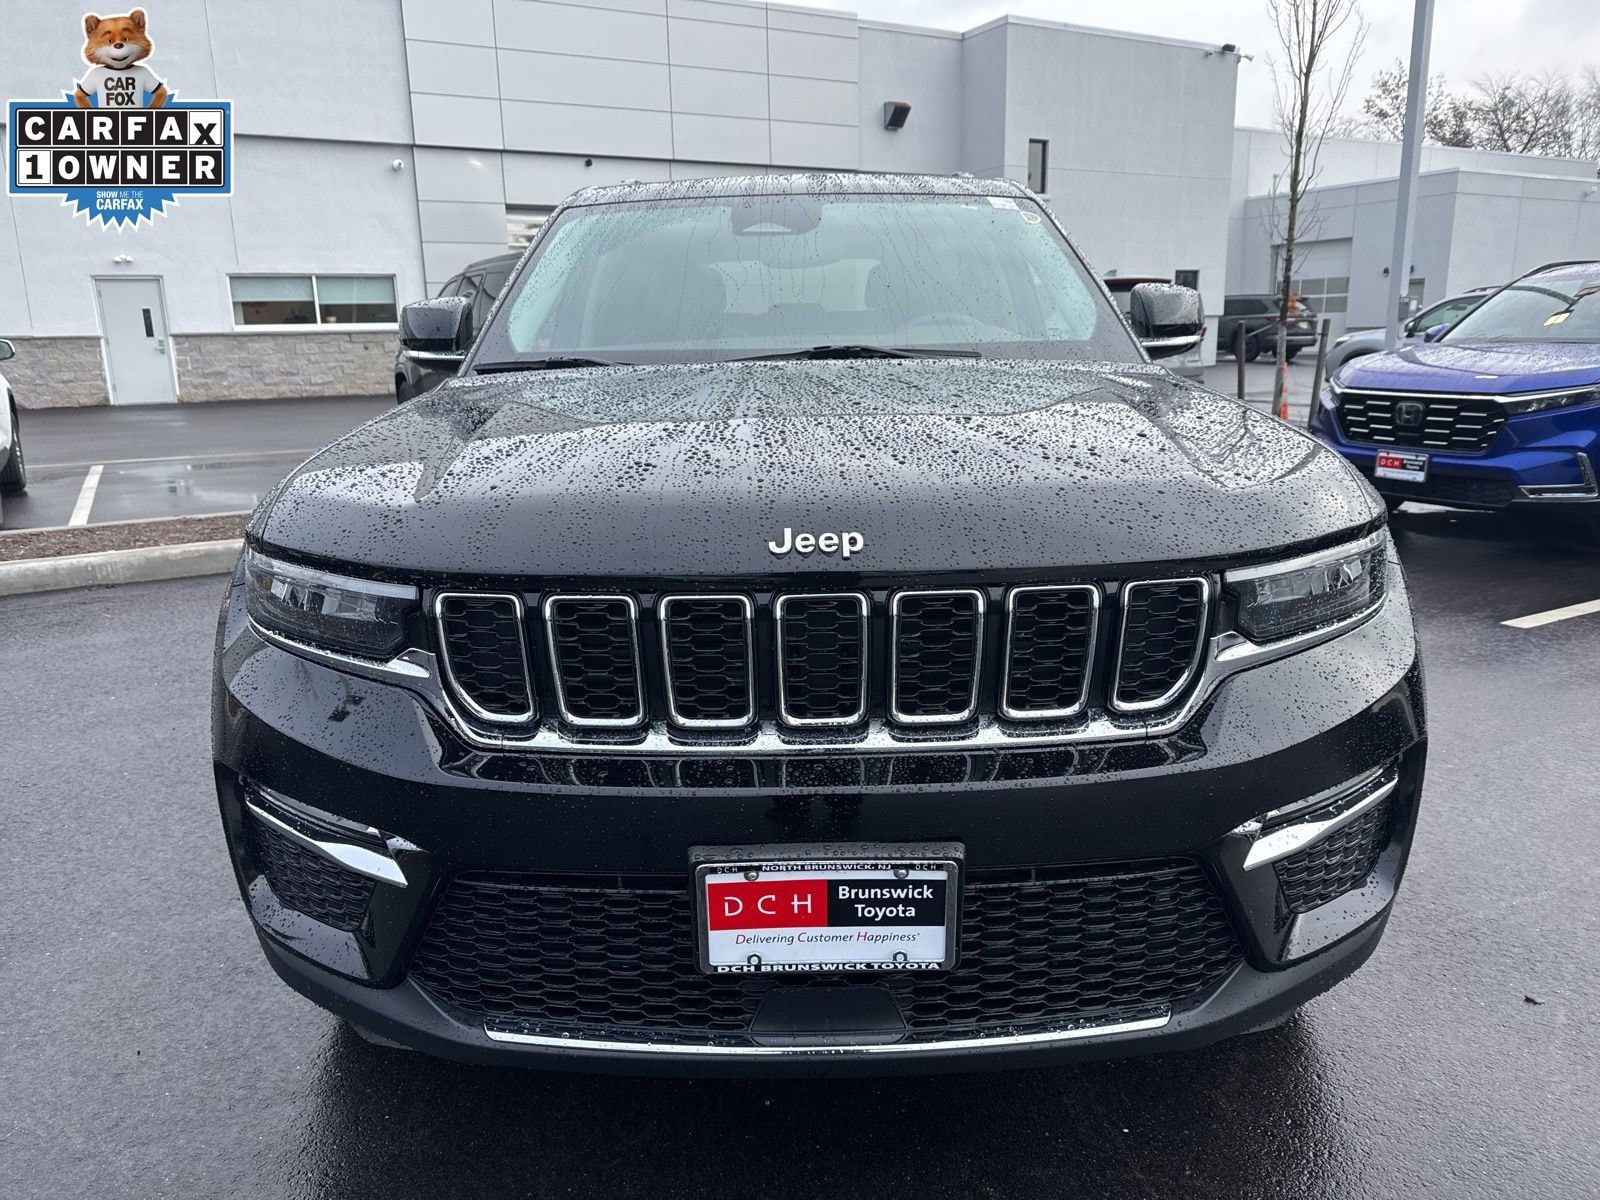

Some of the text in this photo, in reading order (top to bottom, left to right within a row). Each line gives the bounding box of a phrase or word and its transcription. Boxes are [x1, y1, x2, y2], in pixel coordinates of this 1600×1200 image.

[768, 527, 864, 558] Jeep
[838, 885, 934, 899] Brunswick
[854, 904, 916, 921] Toyota
[736, 933, 795, 945] Delivering
[797, 932, 854, 943] Customer
[717, 962, 940, 973] DCH BRUNSWICK TOYOTA
